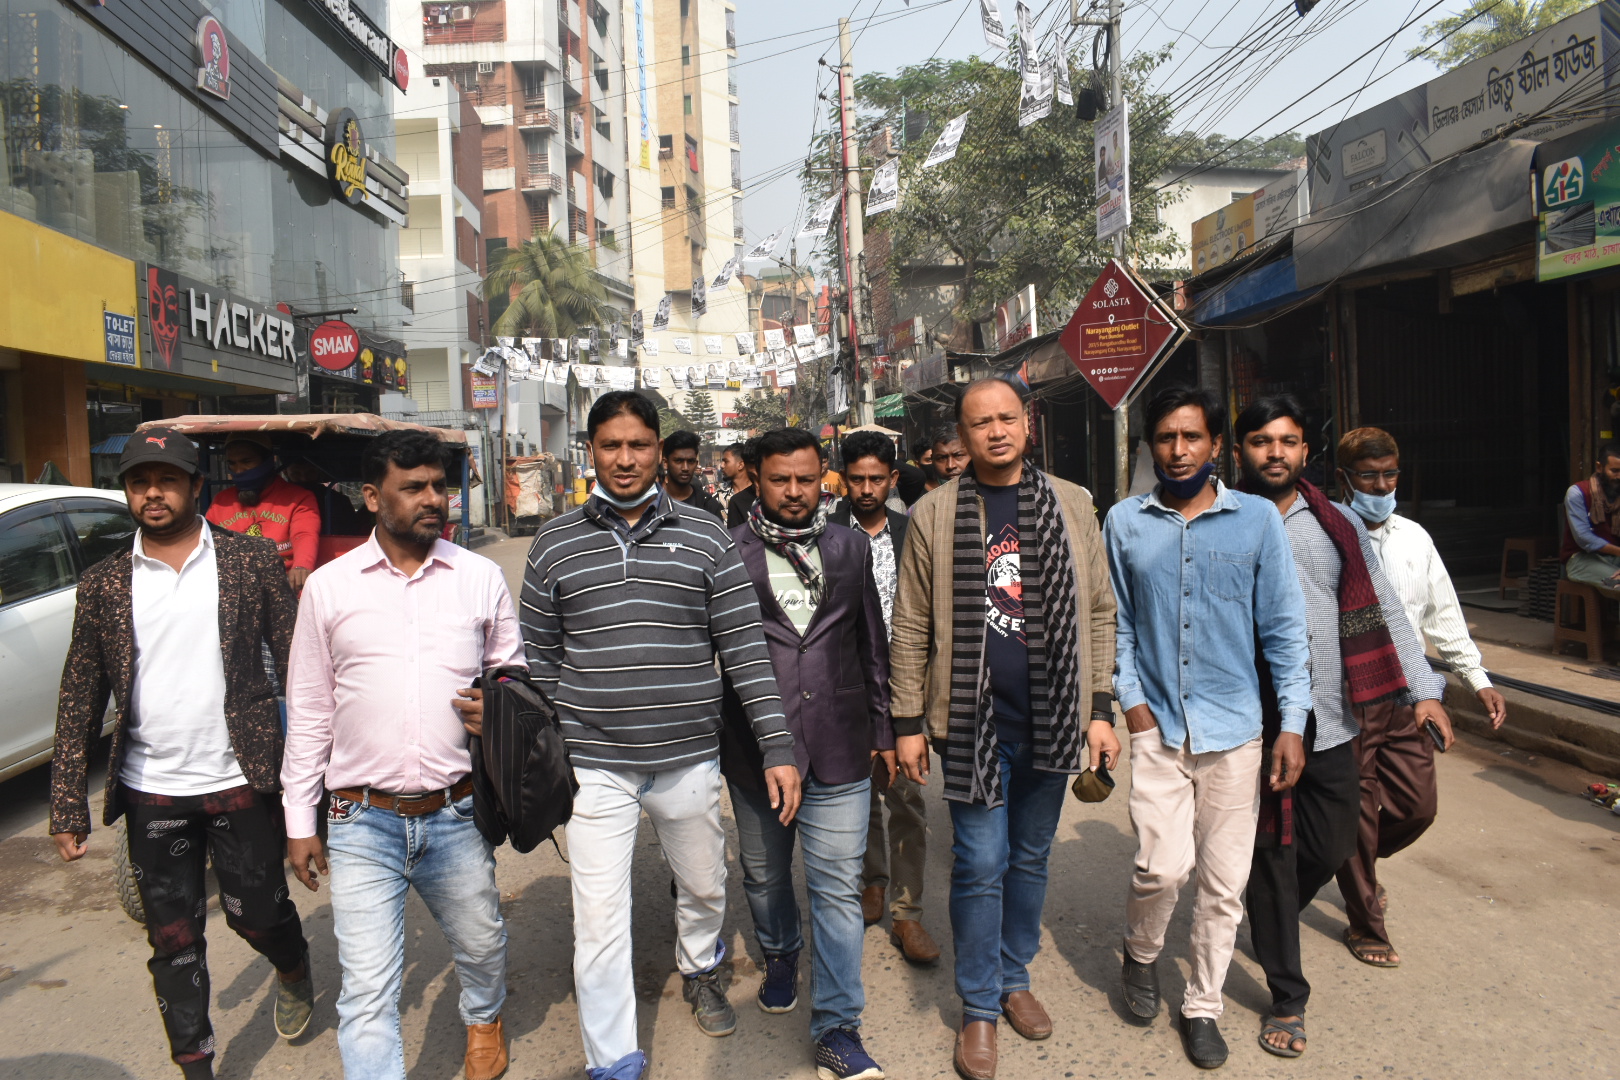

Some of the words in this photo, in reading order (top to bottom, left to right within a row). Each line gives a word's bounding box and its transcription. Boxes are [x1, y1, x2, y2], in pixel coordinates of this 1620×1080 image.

[1486, 66, 1515, 113] জিতু
[1552, 34, 1597, 83] হাউজ
[1350, 146, 1376, 164] FALCON
[1234, 218, 1252, 233] LIMITED
[1092, 297, 1131, 309] SOLASTA
[189, 288, 296, 363] HACKER
[1086, 325, 1121, 335] Narayanganj
[1121, 323, 1140, 331] Outlet
[313, 334, 355, 357] SMAK
[250, 510, 259, 518] A
[260, 510, 289, 525] NASTY
[986, 540, 1020, 570] ROOK
[990, 622, 1009, 638] QUALITY
